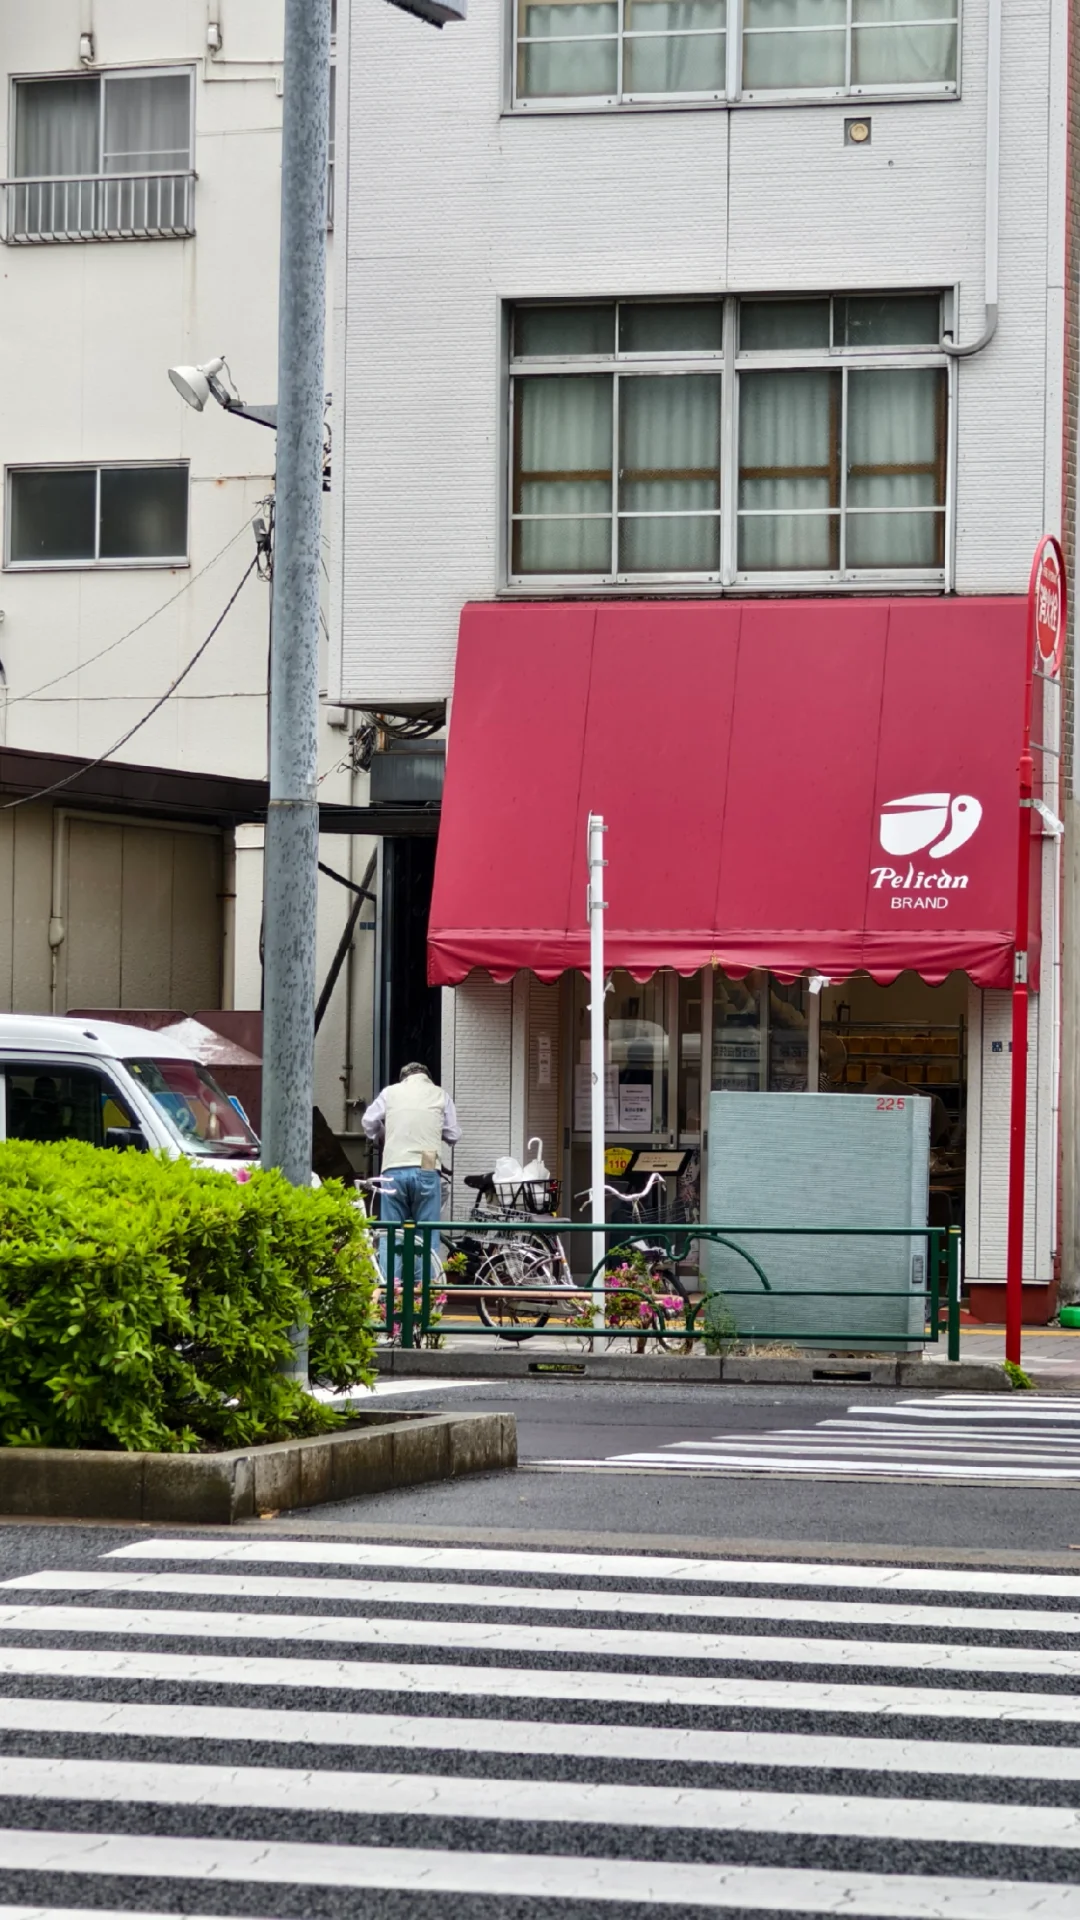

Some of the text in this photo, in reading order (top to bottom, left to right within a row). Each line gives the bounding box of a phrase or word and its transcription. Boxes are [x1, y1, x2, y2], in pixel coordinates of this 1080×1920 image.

[870, 862, 969, 889] Pelican
[891, 897, 949, 909] BRAND
[876, 1097, 906, 1111] 225
[608, 1160, 627, 1169] 110
